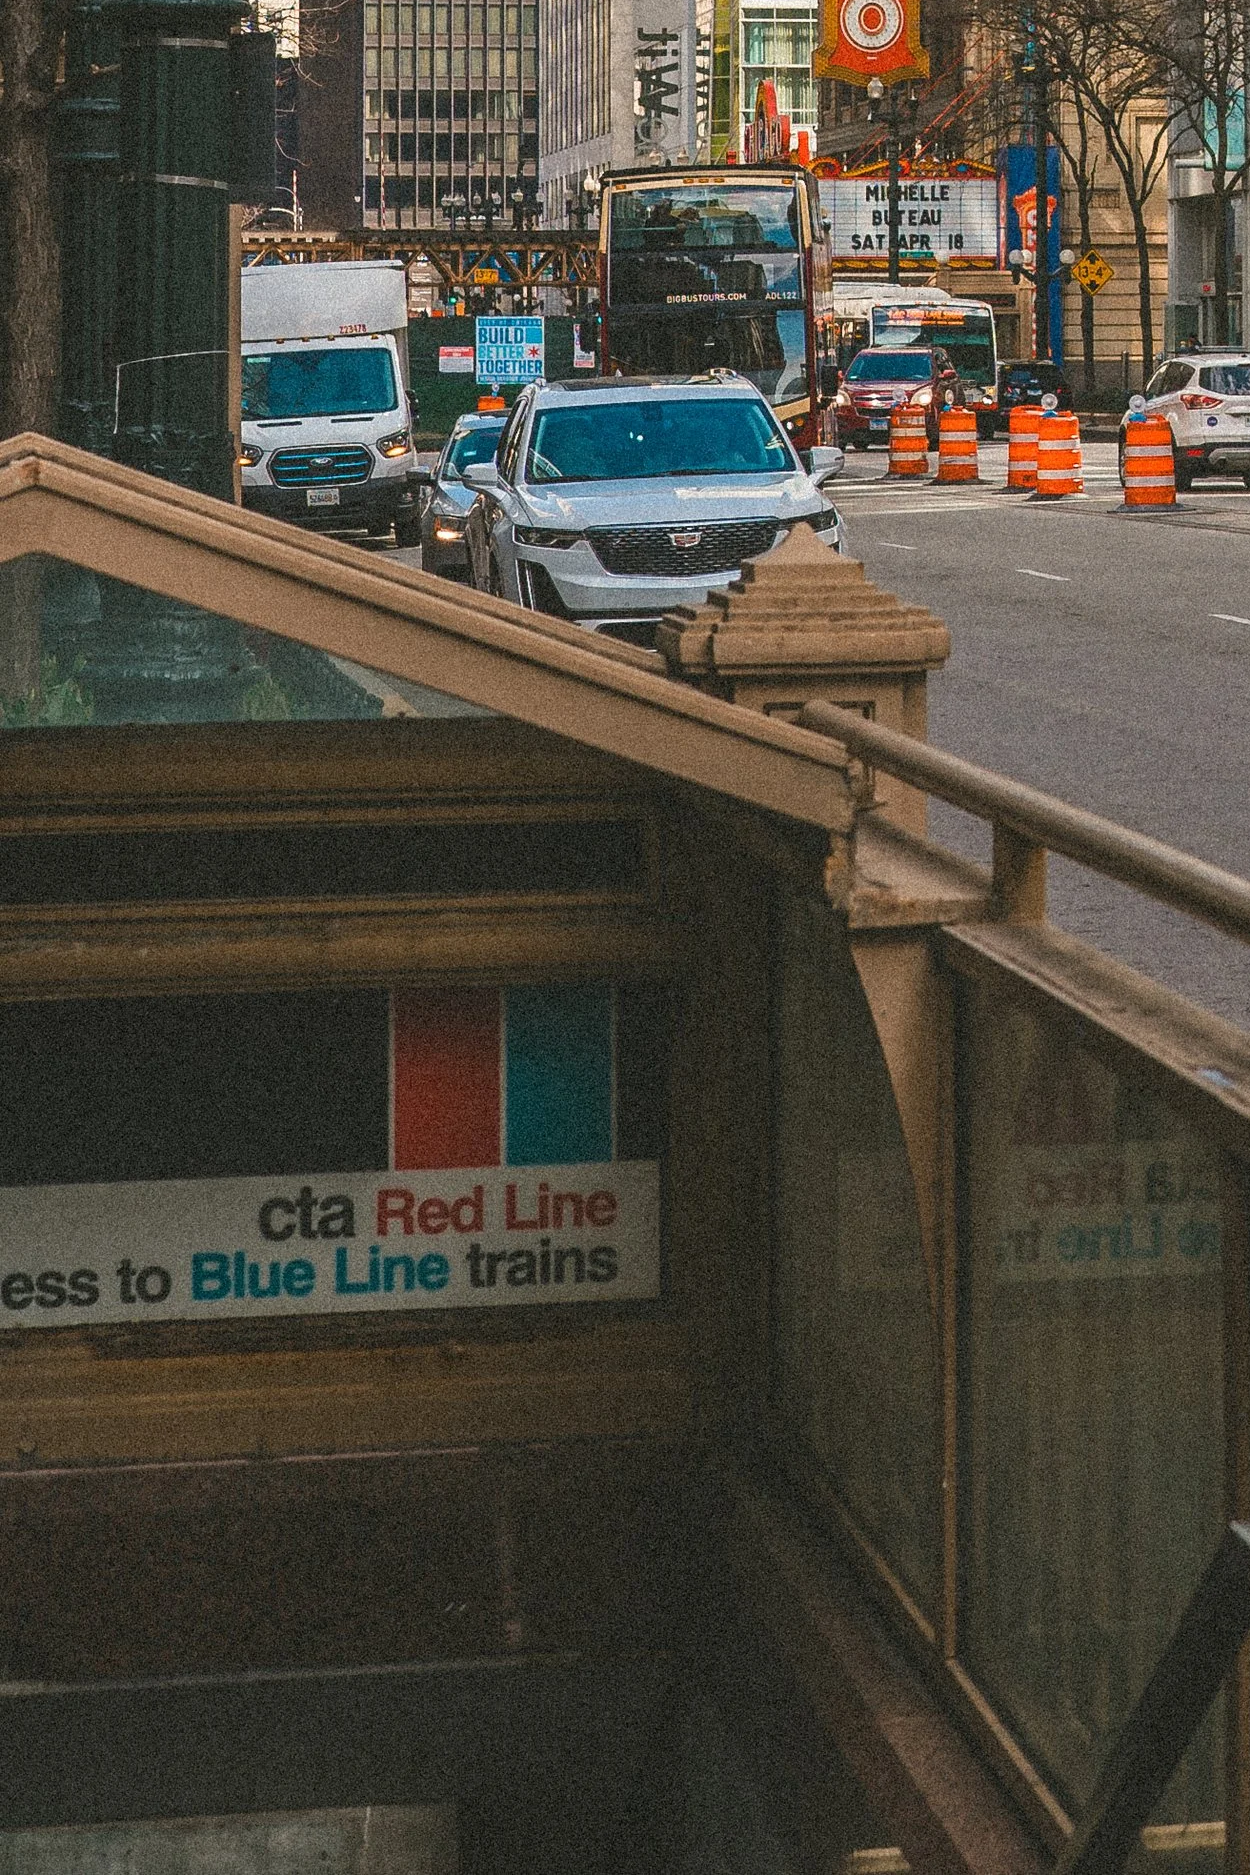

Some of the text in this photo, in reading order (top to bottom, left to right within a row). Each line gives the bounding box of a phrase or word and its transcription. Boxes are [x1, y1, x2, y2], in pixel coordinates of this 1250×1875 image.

[865, 185, 950, 202] MIHELLE
[851, 233, 964, 251] SAT APR 18
[479, 327, 524, 344] BUILD
[478, 345, 524, 359] BETTER
[478, 360, 542, 374] TOGETHER
[258, 1182, 619, 1243] cta Red Line
[117, 1256, 172, 1305] to
[191, 1250, 315, 1302] Blue
[335, 1246, 450, 1295] Line
[466, 1238, 619, 1290] trains
